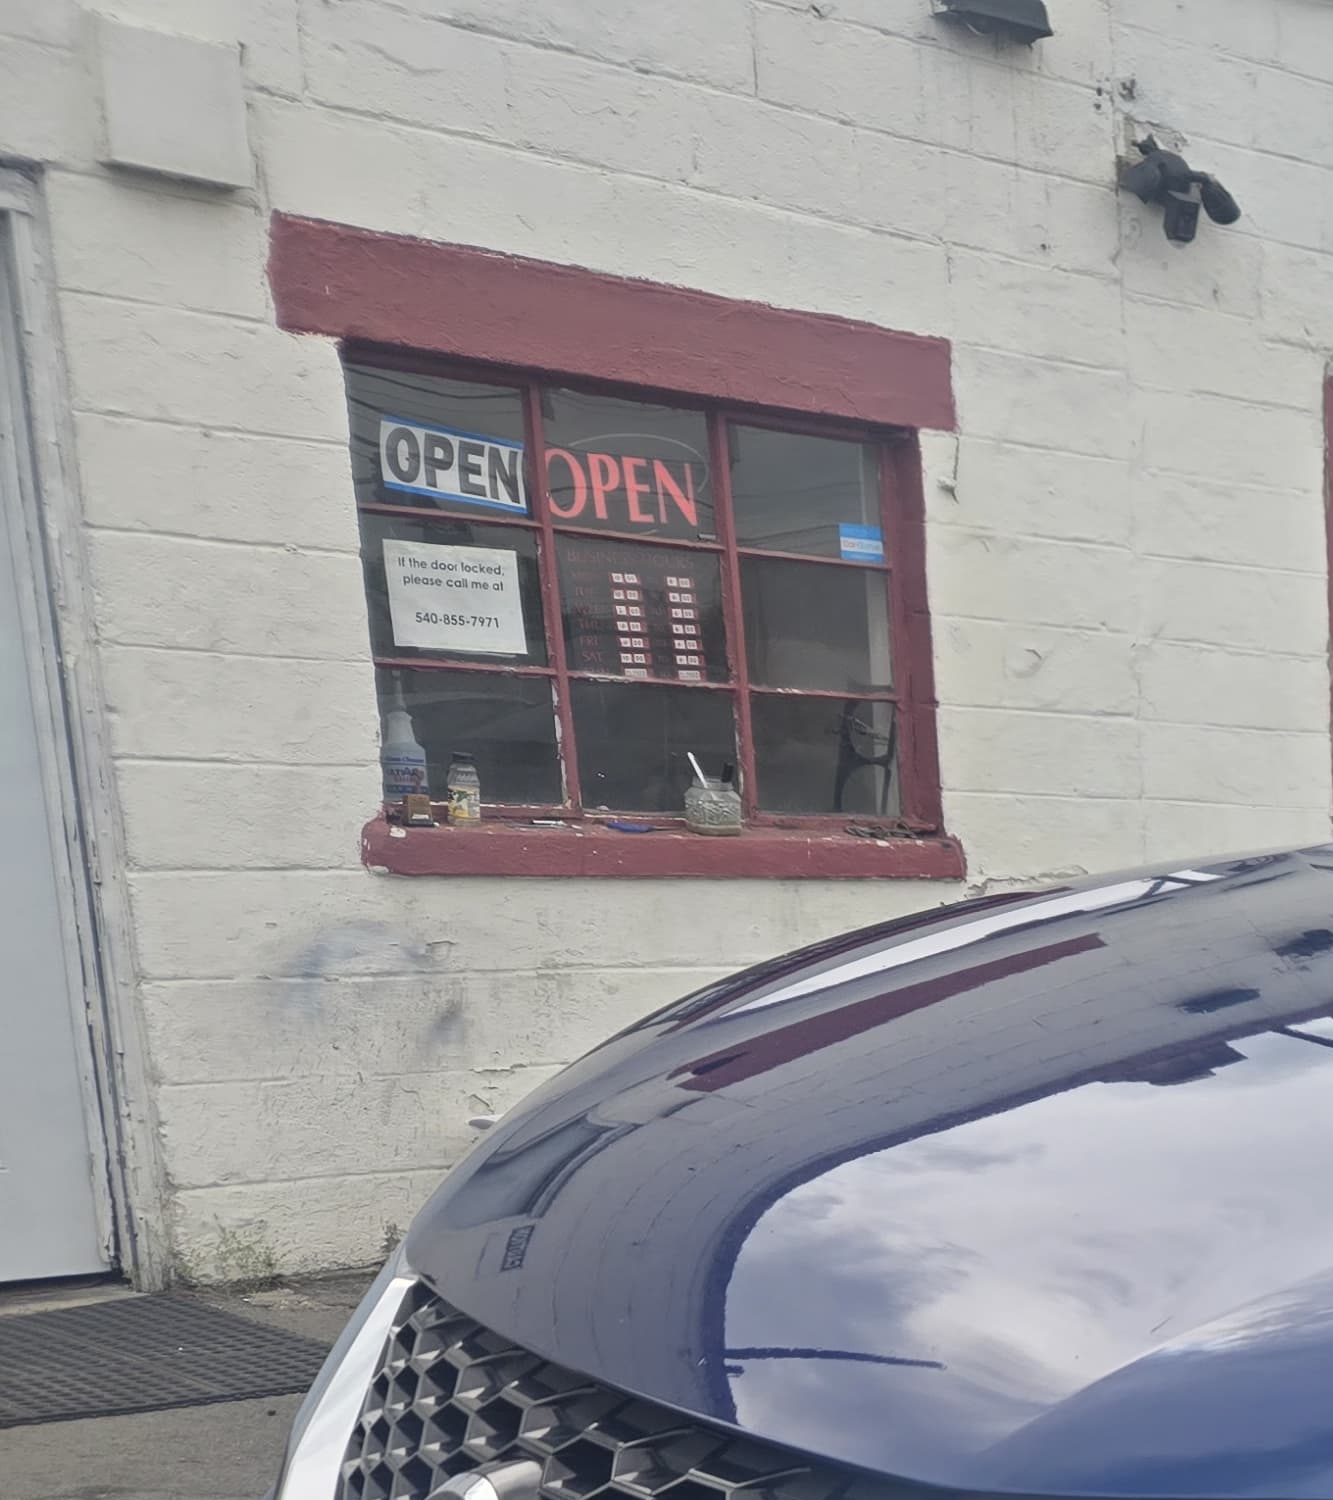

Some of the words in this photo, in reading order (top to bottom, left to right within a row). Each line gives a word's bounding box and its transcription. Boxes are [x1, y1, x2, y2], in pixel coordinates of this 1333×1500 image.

[385, 426, 522, 504] OPEN
[545, 448, 697, 526] OPEN
[409, 558, 427, 569] the
[431, 560, 458, 572] door
[403, 574, 443, 587] please
[446, 578, 468, 589] call
[471, 581, 489, 590] me
[492, 580, 504, 591] at
[416, 611, 500, 628] 540-855-7971
